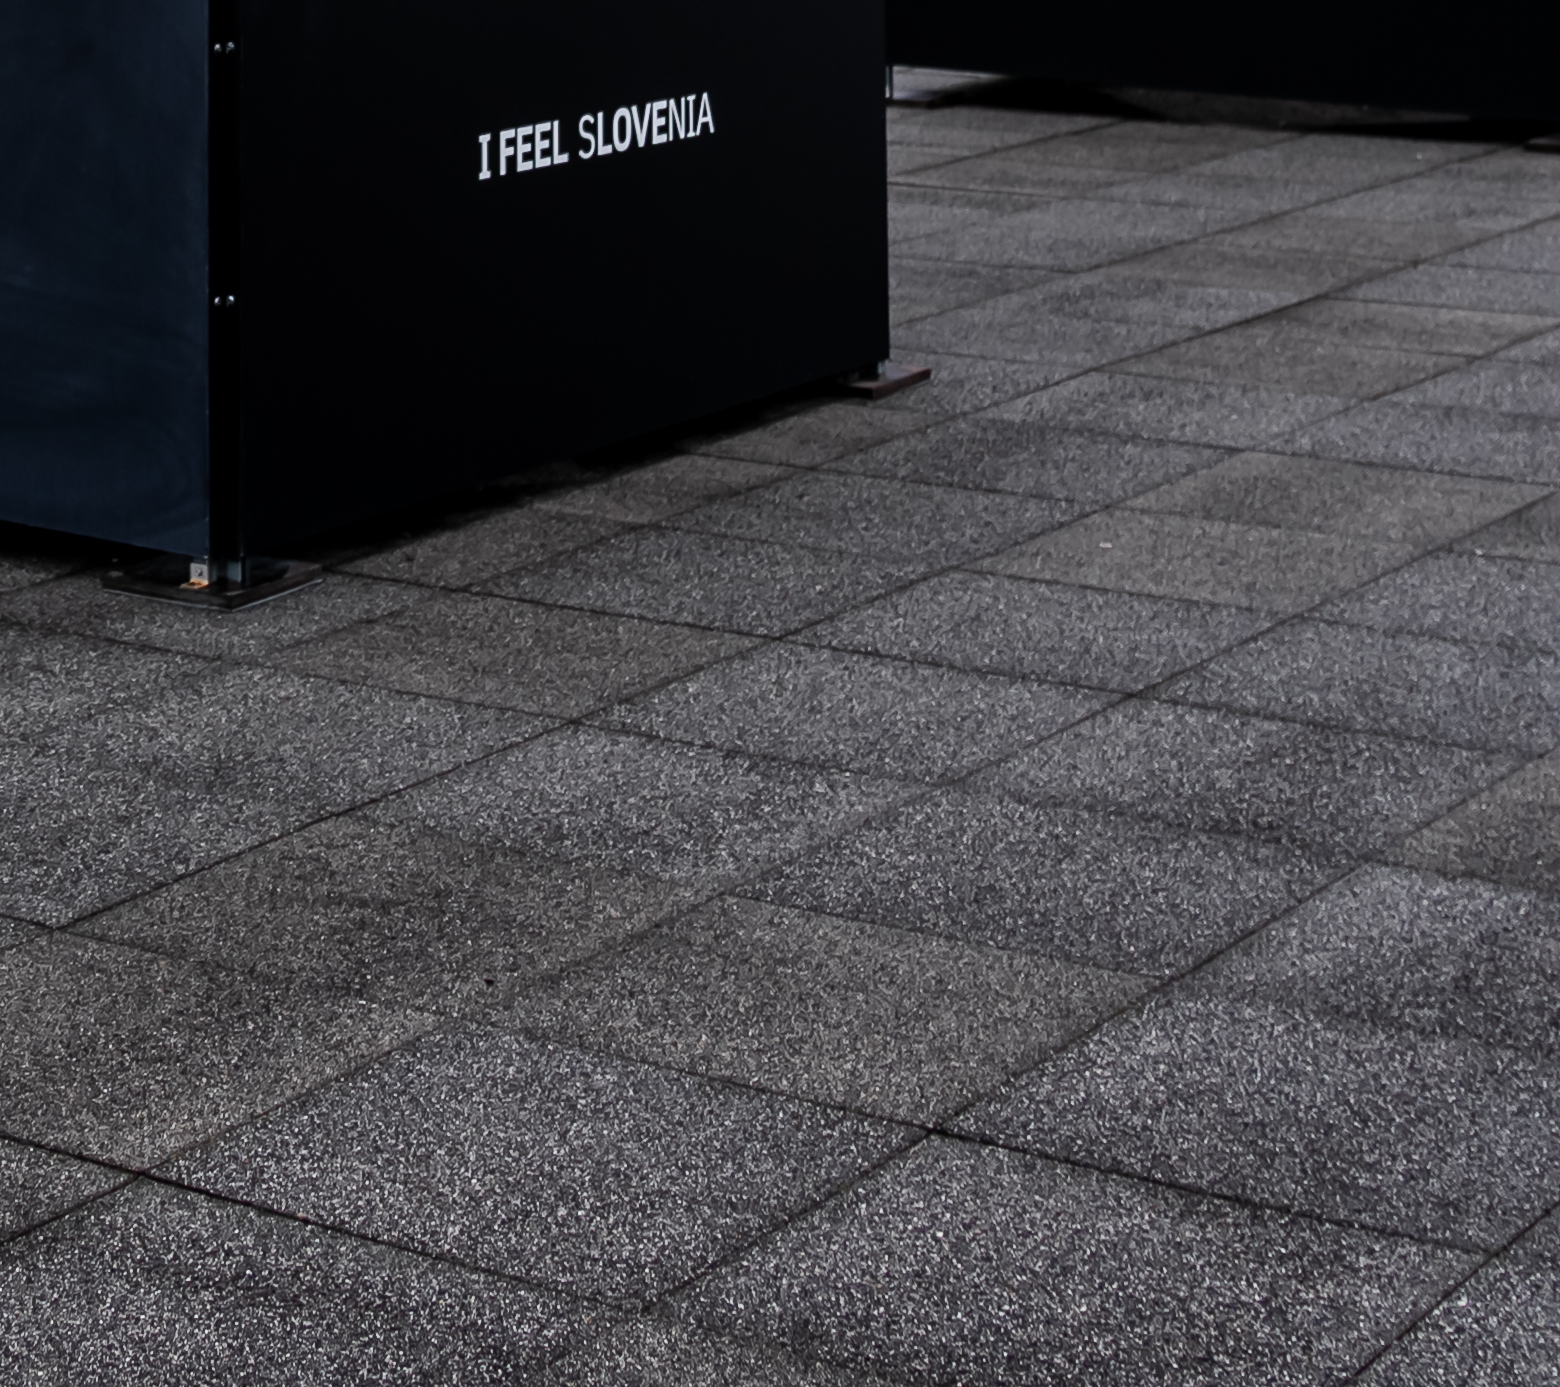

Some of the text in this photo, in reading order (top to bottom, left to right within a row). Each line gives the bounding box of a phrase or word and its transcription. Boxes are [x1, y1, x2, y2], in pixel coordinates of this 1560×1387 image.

[479, 92, 714, 180] I FEEL SLOVENIA
